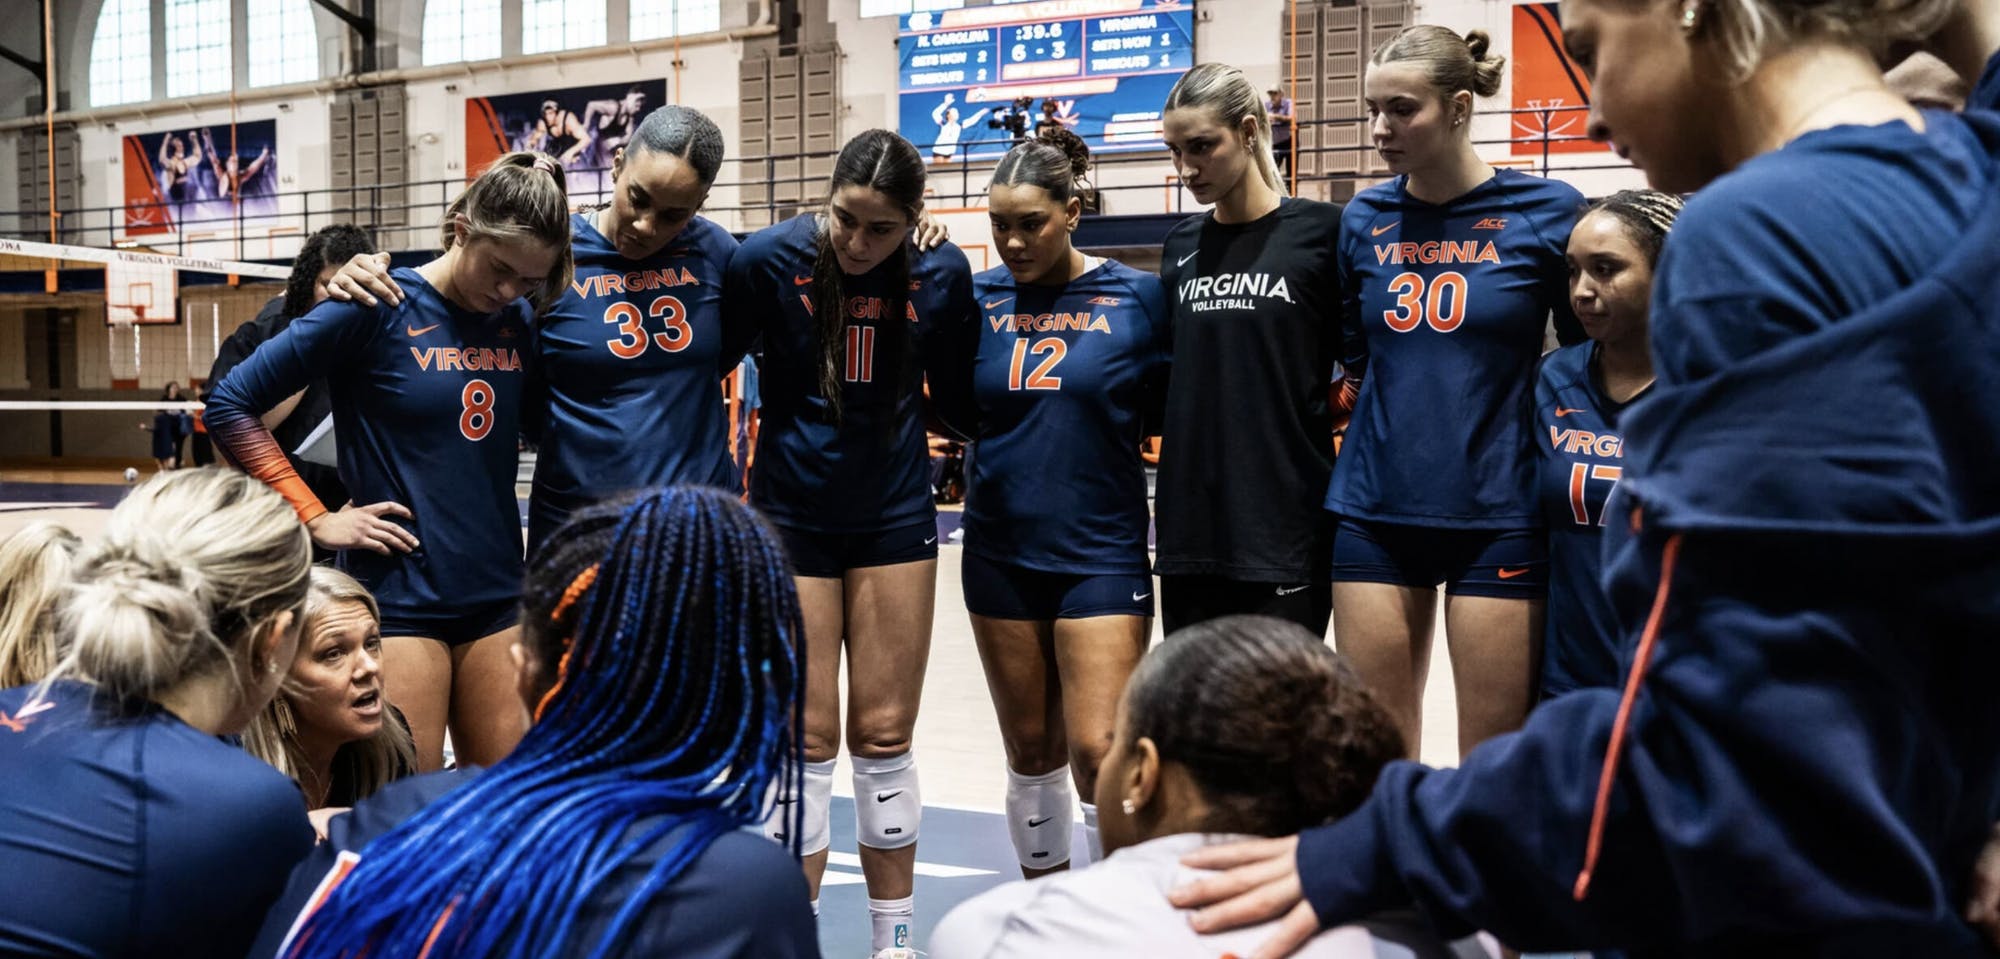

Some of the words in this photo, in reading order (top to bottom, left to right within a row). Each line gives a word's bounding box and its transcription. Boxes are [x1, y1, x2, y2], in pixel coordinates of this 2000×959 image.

[1015, 23, 1063, 40] :39.6
[1099, 15, 1157, 33] VIRGINIA
[932, 29, 989, 46] CAROLINA
[1160, 32, 1171, 46] 1
[977, 50, 987, 63] 2
[1011, 43, 1027, 62] 6
[1051, 40, 1066, 59] 3
[1160, 53, 1170, 67] 1
[977, 68, 987, 81] 2
[1471, 218, 1508, 230] ACC
[117, 252, 163, 265] VIRGINIA
[167, 258, 224, 270] VOLLEYBALL
[1373, 240, 1501, 266] VIRGINIA
[571, 266, 699, 299] VIRGINIA
[1087, 295, 1120, 307] ACC
[1192, 299, 1256, 313] VOLLEYBALL
[1383, 271, 1468, 332] 30
[603, 295, 693, 359] 33
[988, 311, 1112, 335] VIRGINIA
[410, 346, 522, 372] VIRGINIA
[845, 325, 875, 382] 11
[1008, 337, 1068, 391] 12
[459, 379, 495, 441] 8
[1569, 462, 1622, 527] 17
